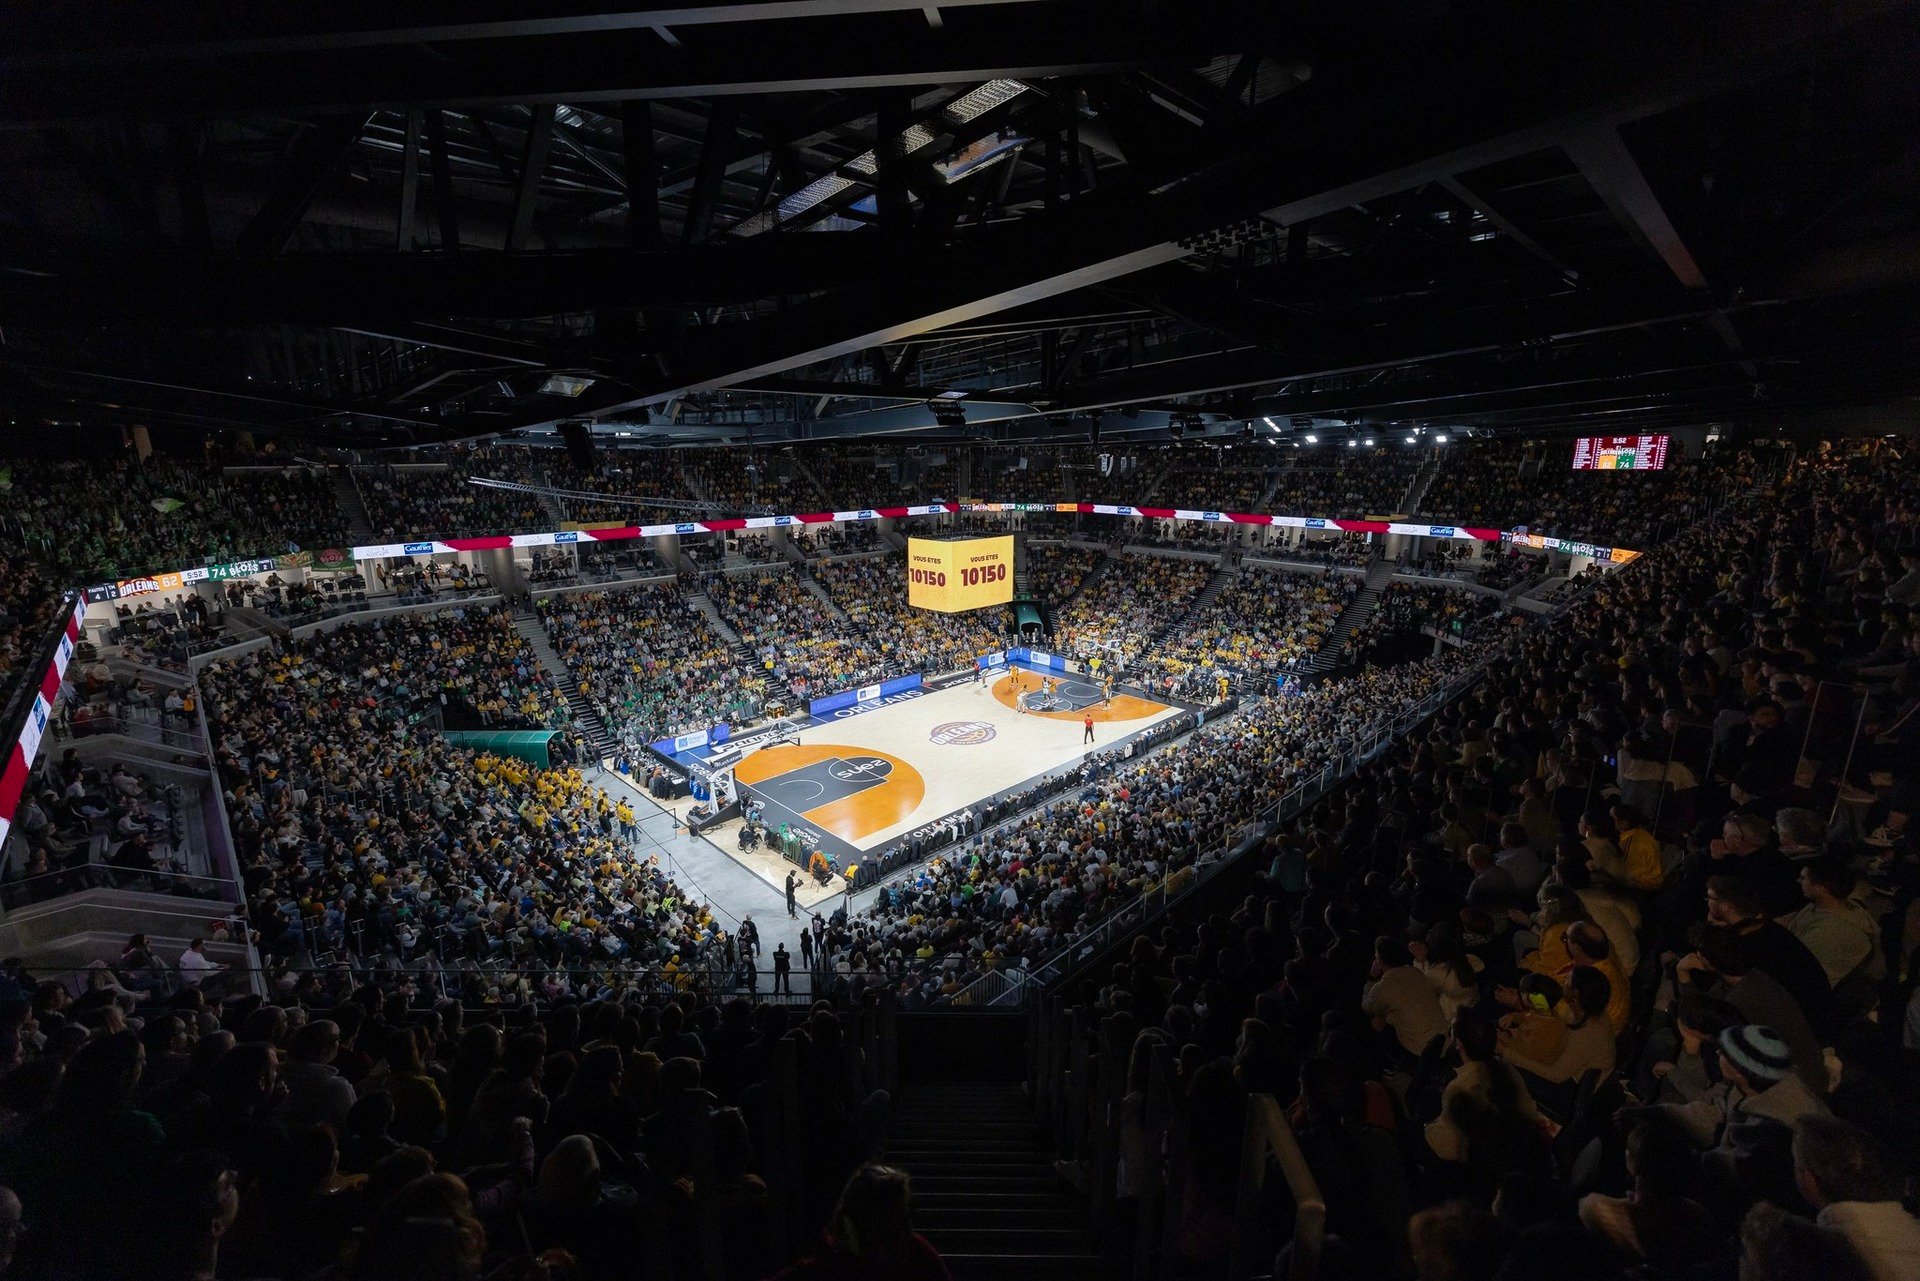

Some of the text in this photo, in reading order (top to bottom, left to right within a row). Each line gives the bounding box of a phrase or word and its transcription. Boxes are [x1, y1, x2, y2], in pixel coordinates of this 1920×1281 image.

[404, 543, 432, 552] Gauthier
[1561, 542, 1570, 551] 74
[187, 571, 203, 579] 5:52
[212, 568, 226, 578] 74
[229, 563, 259, 576] BLOIS
[961, 563, 1006, 587] 10150
[162, 576, 178, 587] 62
[910, 568, 946, 587] 10150
[120, 580, 160, 597] ORLEANS
[834, 690, 924, 718] ORLEANS
[930, 722, 995, 745] ORLEANS
[837, 759, 887, 779] suez
